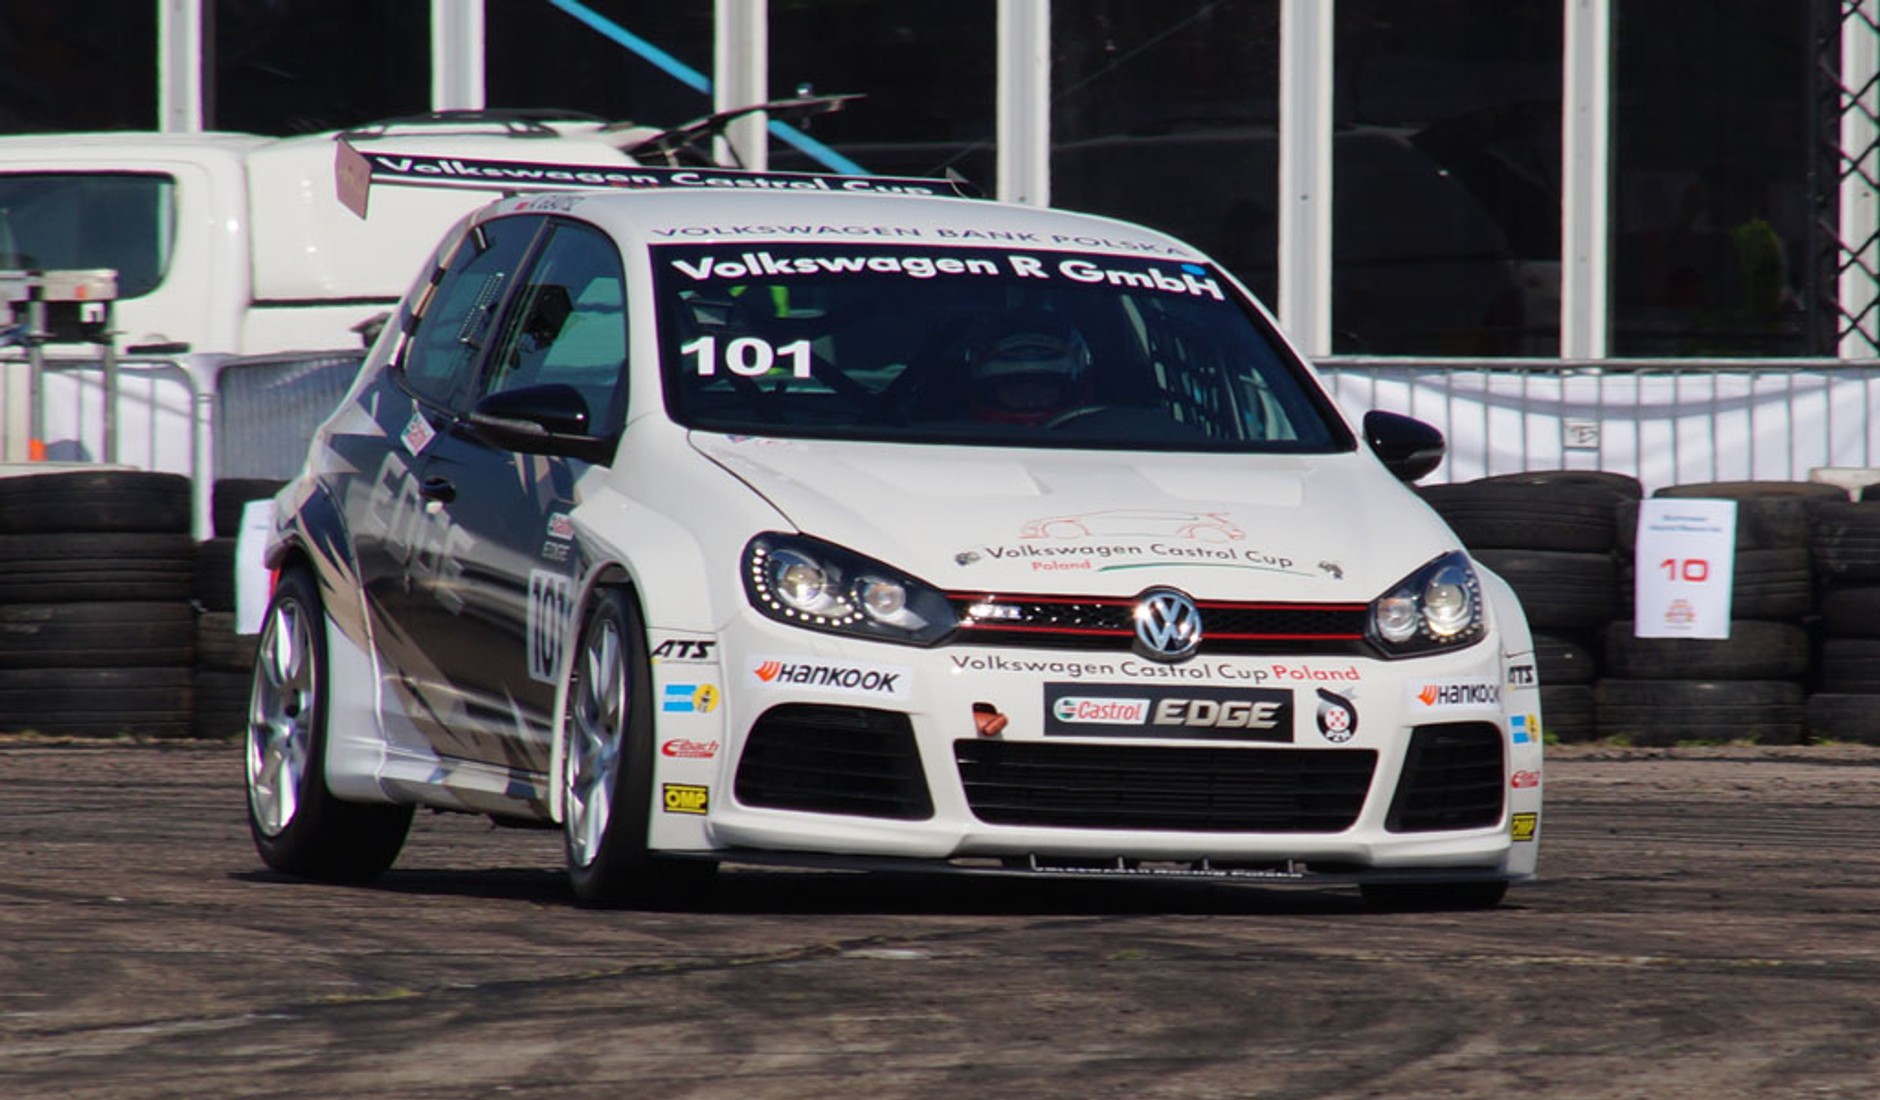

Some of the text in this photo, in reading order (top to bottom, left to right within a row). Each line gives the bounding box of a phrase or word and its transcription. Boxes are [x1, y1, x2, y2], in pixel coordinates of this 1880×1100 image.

[652, 225, 1189, 255] VOLKSWAGEN BANK POLSKA
[671, 252, 1226, 301] Volkswagen R GmbH
[680, 336, 811, 379] 101
[985, 543, 1294, 569] Volkswagen Castrol Cup
[1031, 560, 1093, 572] Poland
[1659, 558, 1709, 582] 10
[651, 639, 717, 659] ATS
[951, 655, 1361, 684] Volkswagen Castrol Cup Poland
[1077, 698, 1282, 729] Castrol EDGE
[665, 789, 706, 809] OMP
